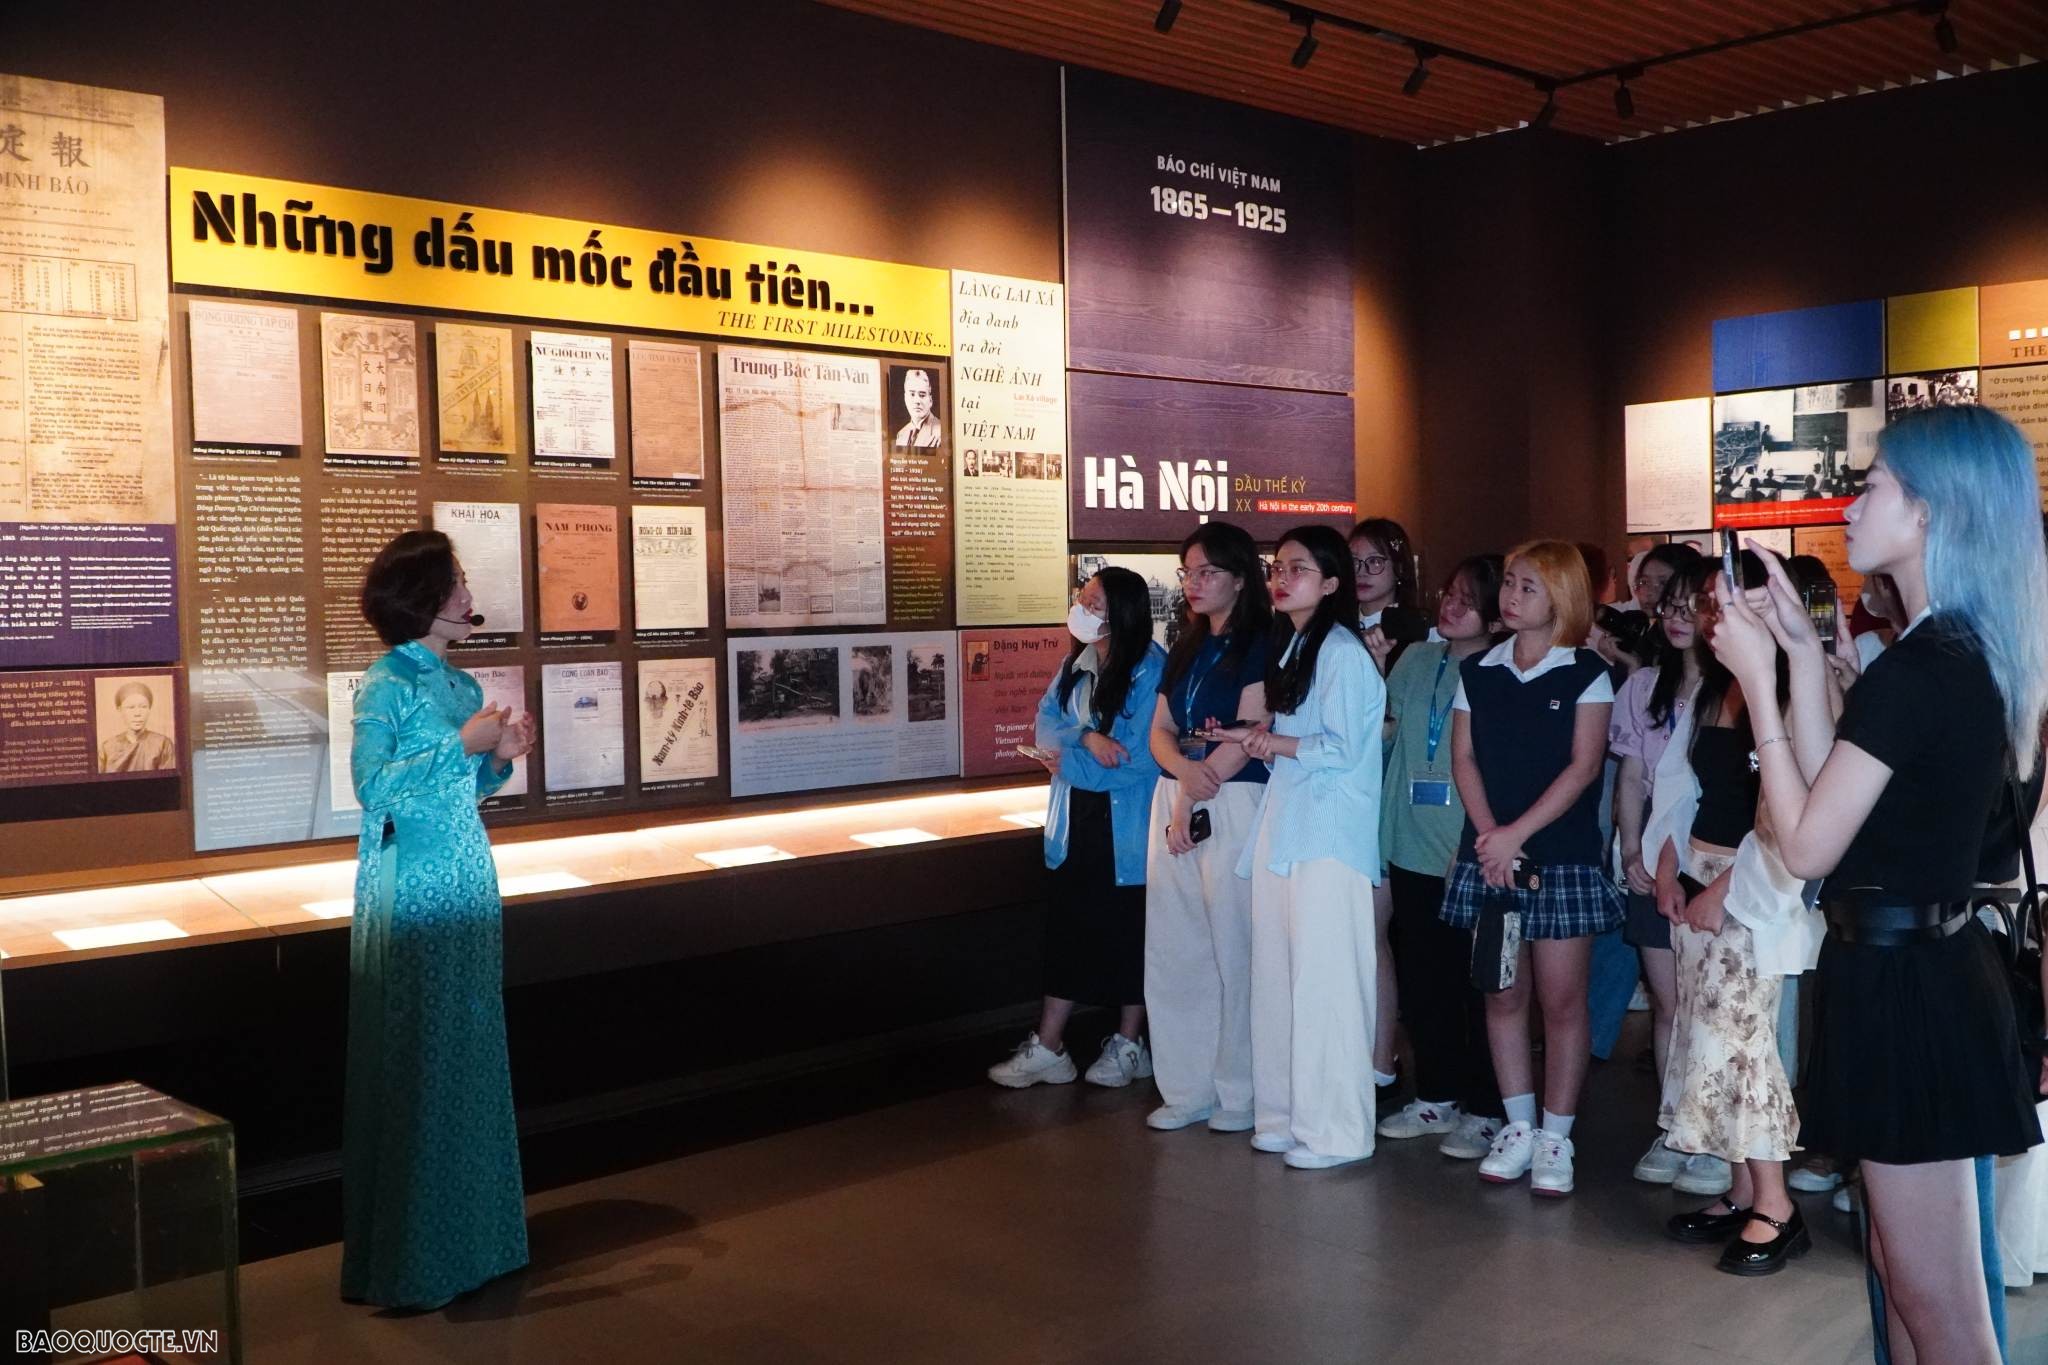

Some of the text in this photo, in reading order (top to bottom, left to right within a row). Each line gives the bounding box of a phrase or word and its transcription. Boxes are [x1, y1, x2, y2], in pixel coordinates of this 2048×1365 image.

[1157, 153, 1281, 193] BÁO CHÍ VIỆT NAM
[50, 176, 89, 195] BÁO
[193, 190, 393, 274] Những
[414, 212, 513, 275] dấu
[532, 230, 633, 289] mốc
[649, 241, 732, 300] đầu
[959, 279, 1055, 306] LÀNG LAI XÁ
[717, 310, 757, 331] THE
[763, 315, 819, 337] FIRST
[960, 340, 1002, 355] ra đời
[2011, 345, 2047, 358] THE
[960, 362, 1042, 386] NGHỀ ẢNH
[961, 395, 981, 413] tại
[962, 419, 1036, 442] VIỆT NAM
[1084, 454, 1228, 525] Hà Nội
[1235, 474, 1260, 492] ĐẦU
[1265, 475, 1287, 493] THẾ
[1235, 499, 1251, 512] XX
[1259, 501, 1353, 514] Hà Nội in the early 20th century
[545, 522, 612, 533] NAM PHONG
[1021, 639, 1040, 651] Huy
[995, 724, 1006, 733] The
[1006, 723, 1028, 734] pioneer
